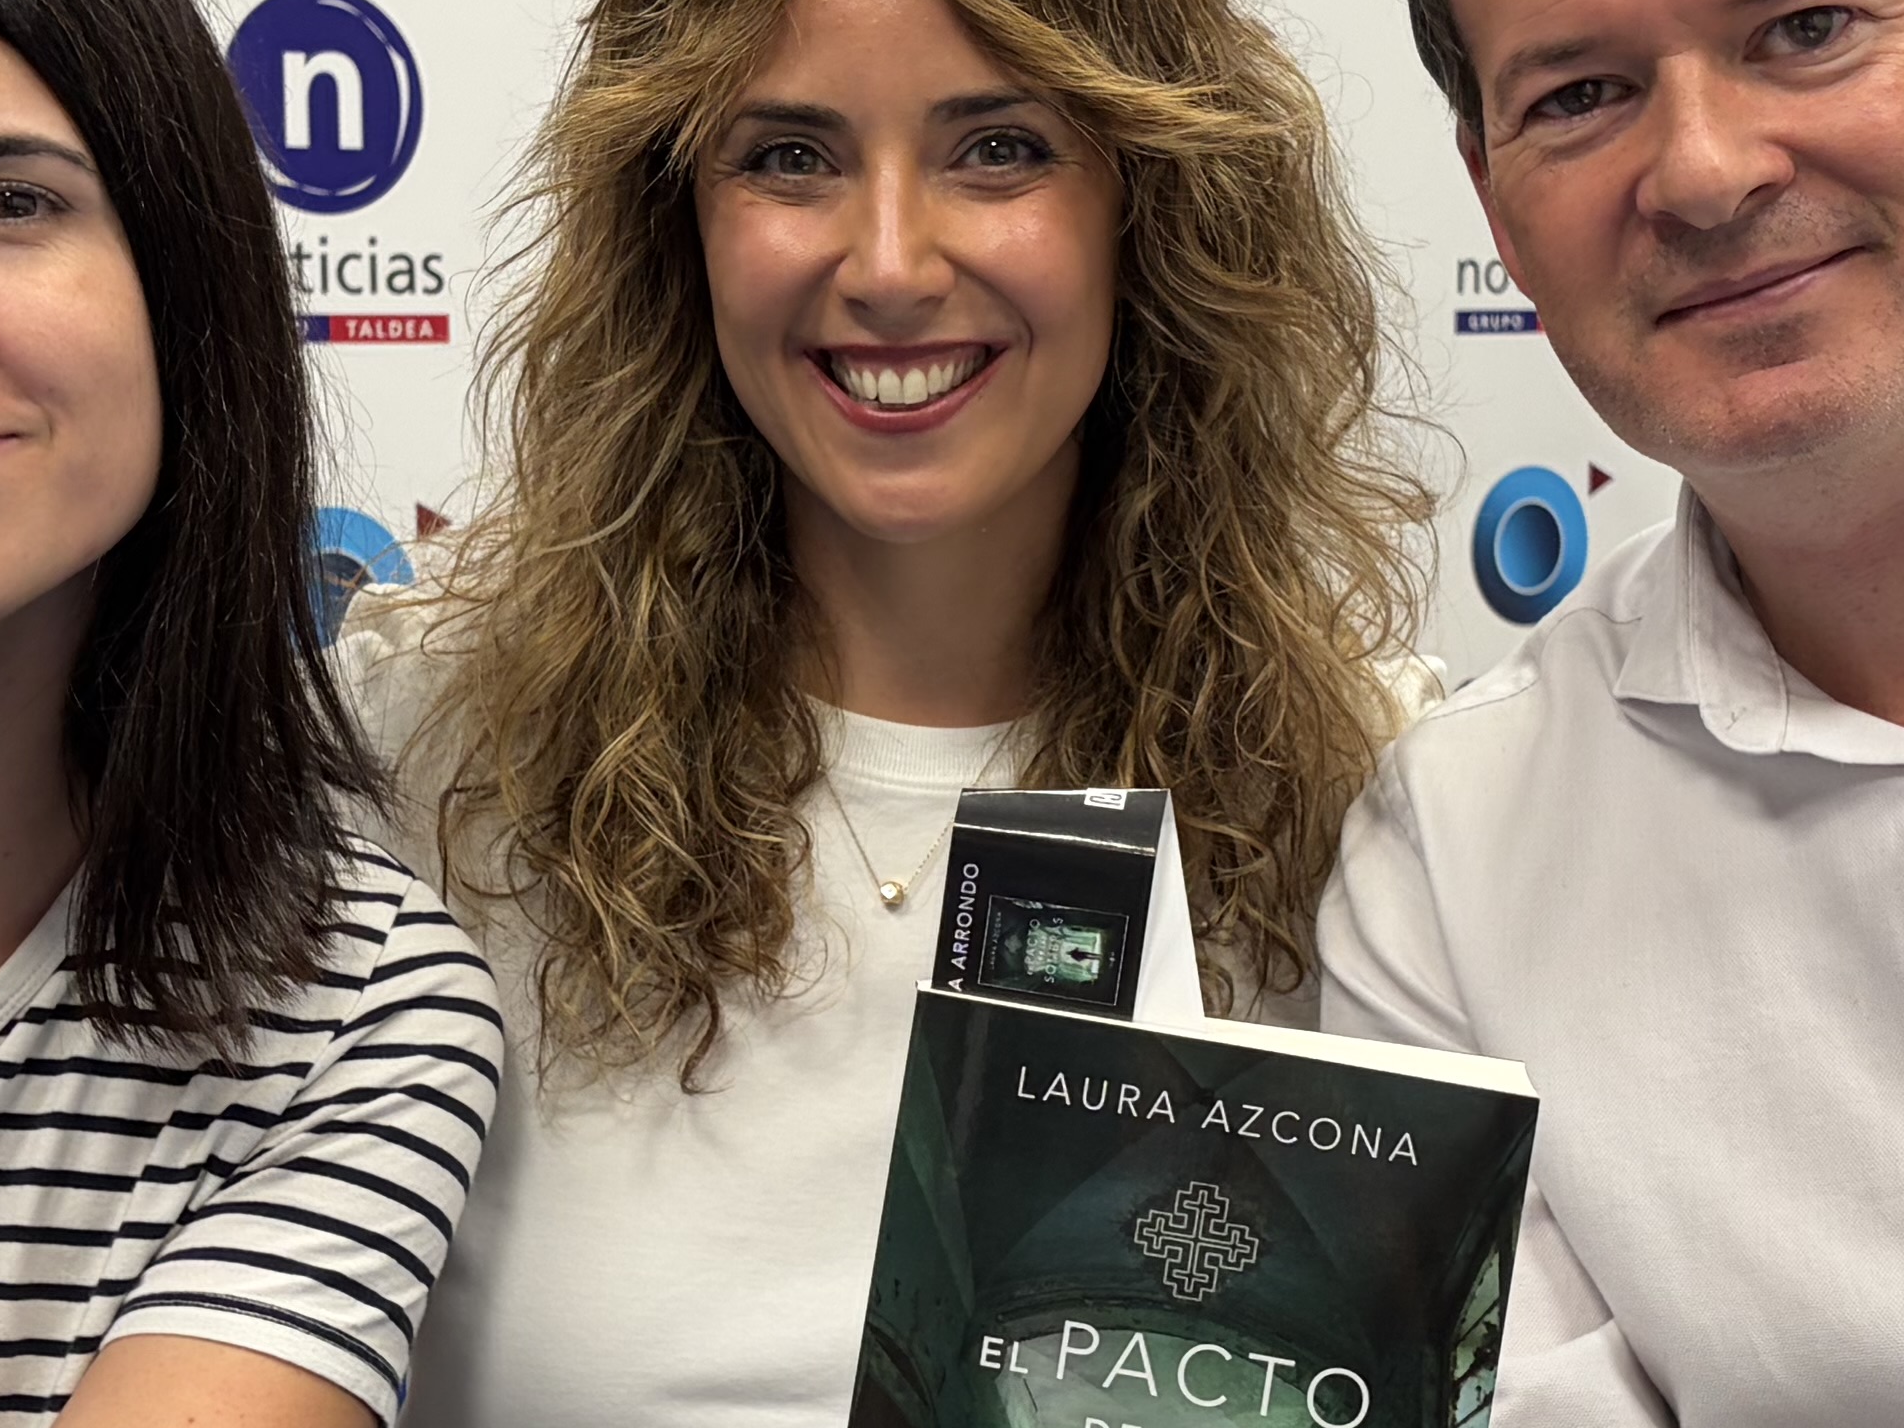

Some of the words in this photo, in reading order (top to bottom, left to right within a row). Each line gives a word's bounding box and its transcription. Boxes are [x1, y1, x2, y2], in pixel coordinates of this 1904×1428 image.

[281, 50, 364, 151] n
[291, 236, 445, 295] ticias
[345, 319, 434, 339] TALDEA
[950, 862, 980, 970] ARRONDO
[1016, 1065, 1177, 1125] LAURA
[1200, 1100, 1419, 1167] AZCONA
[979, 1335, 1030, 1375] EL
